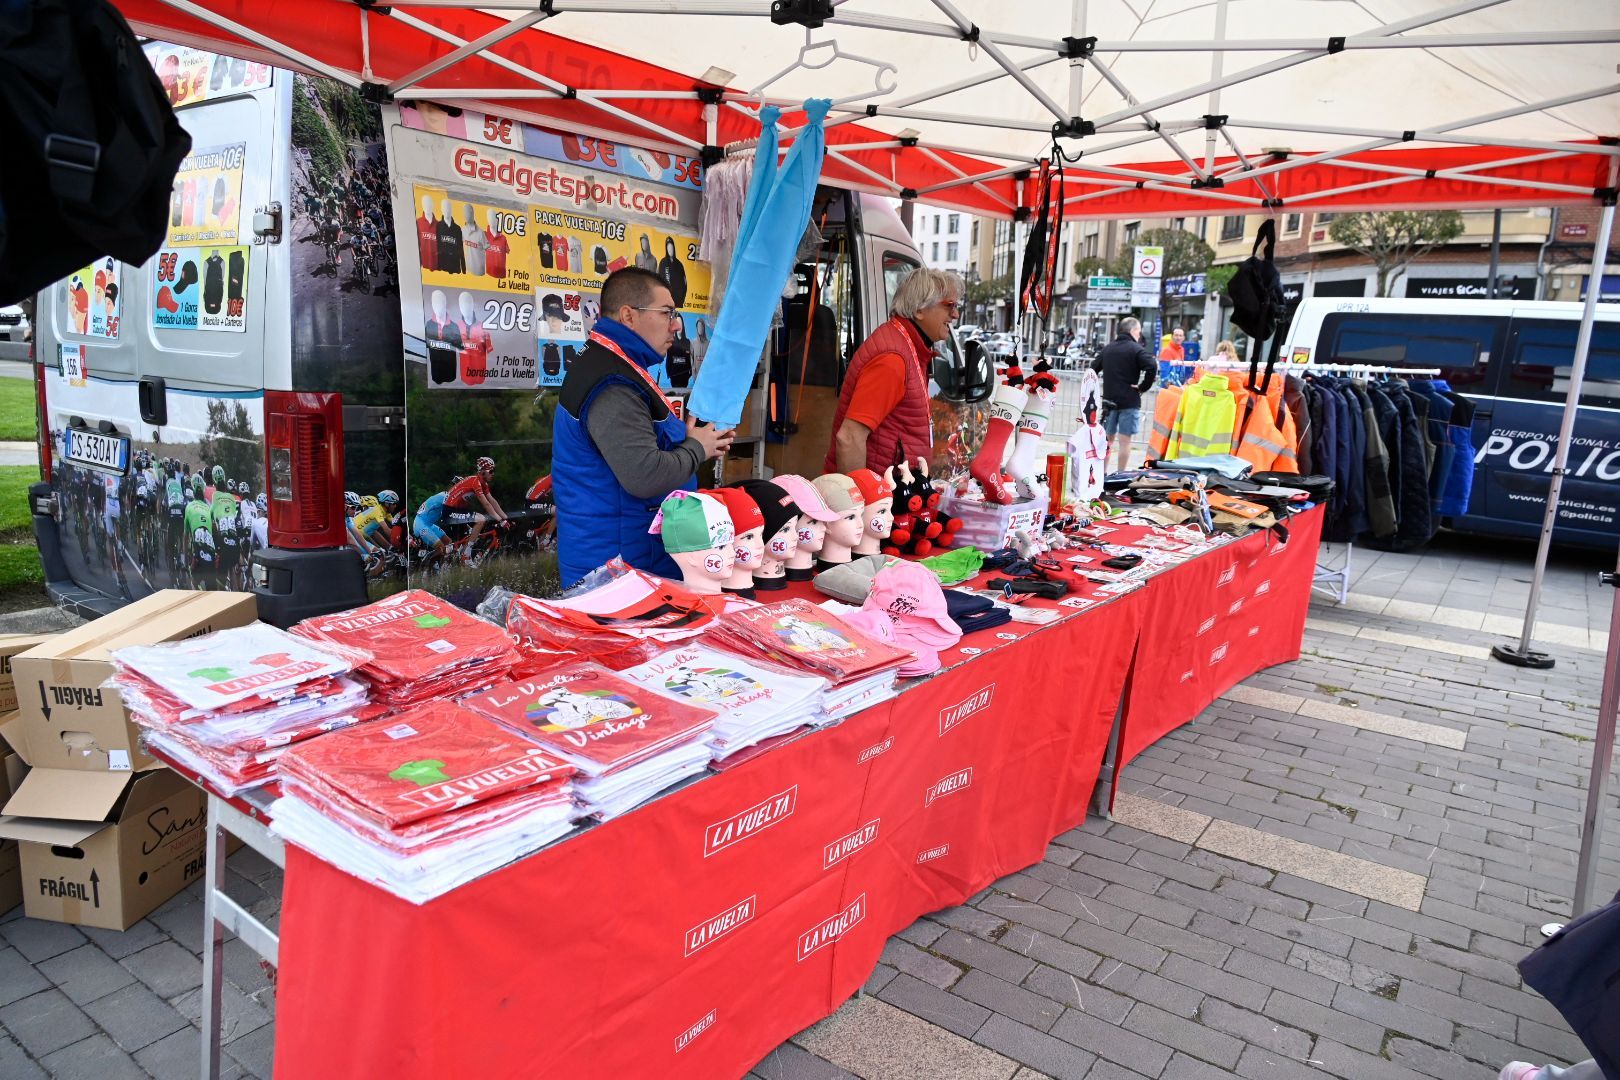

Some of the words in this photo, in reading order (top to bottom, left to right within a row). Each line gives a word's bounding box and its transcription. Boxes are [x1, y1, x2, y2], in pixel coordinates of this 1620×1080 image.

[483, 115, 513, 145] 5€
[195, 152, 219, 169] VUELTA
[221, 145, 243, 169] 10€
[579, 136, 618, 167] 3€
[454, 148, 678, 217] Gadgetsport.com
[674, 157, 702, 187] 5€
[496, 211, 527, 237] 10€
[535, 209, 563, 227] PACK
[564, 215, 601, 234] VUELTA
[600, 219, 626, 242] 10€
[157, 252, 179, 282] 5€
[507, 269, 511, 278] 1
[514, 269, 530, 280] Polo
[497, 279, 506, 289] La
[508, 280, 530, 291] Vuelta
[545, 274, 571, 286] Camiseta
[1421, 287, 1454, 295] VIAJES
[226, 297, 245, 317] 10€
[563, 293, 582, 311] 5€
[1336, 303, 1354, 312] UPR
[1356, 303, 1370, 312] 12A
[105, 315, 120, 338] 5€
[481, 299, 535, 332] 20€
[466, 367, 499, 378] bordado
[500, 368, 510, 378] La
[512, 368, 535, 379] Vuelta
[502, 355, 520, 366] Polo
[521, 356, 535, 368] Top
[71, 432, 82, 457] CS
[85, 434, 119, 466] 530AY
[1491, 428, 1544, 441] CUERPO
[1545, 434, 1611, 449] NAIONAL
[1508, 493, 1617, 513] www.olicia.es
[872, 519, 884, 531] 3€
[1559, 510, 1613, 523] @policia
[772, 541, 785, 551] 5€
[798, 530, 810, 541] 5€
[706, 560, 721, 569] 5€
[735, 549, 749, 561] 5€
[50, 685, 103, 711] FRÁGIL
[488, 693, 519, 708] La
[517, 674, 582, 697] Vuelta
[944, 711, 957, 729] LA
[957, 689, 989, 722] VUELTA
[564, 713, 653, 748] Vintage
[422, 785, 458, 803] LA
[456, 756, 557, 794] VUELTA
[937, 771, 968, 795] VUELTA
[712, 823, 734, 849] LA
[736, 794, 790, 836] VUELTA
[828, 844, 841, 863] LA
[841, 824, 876, 853] VUELTA
[39, 876, 90, 902] FRÁGIL
[690, 929, 706, 949] LA
[707, 902, 750, 940] VUELTA
[803, 932, 819, 954] LA
[820, 901, 861, 940] VUELTA
[678, 1035, 689, 1048] LA
[689, 1013, 714, 1042] VUELTA
